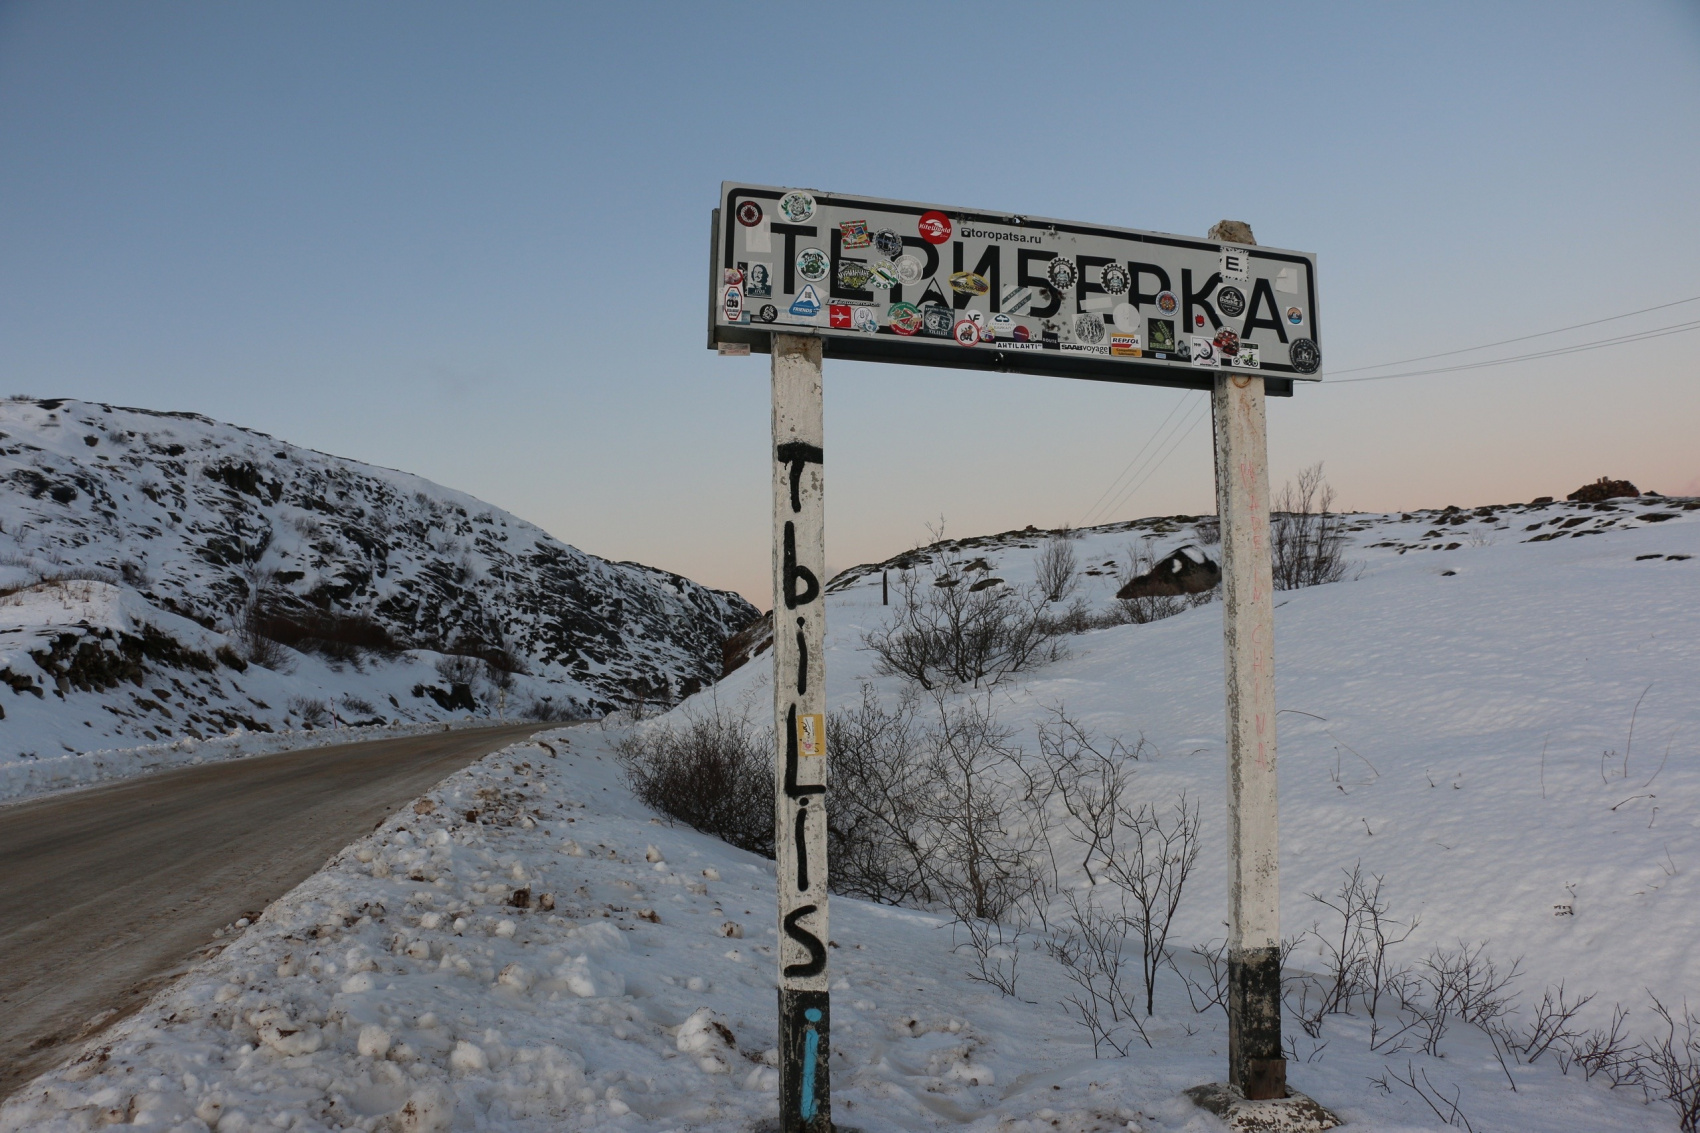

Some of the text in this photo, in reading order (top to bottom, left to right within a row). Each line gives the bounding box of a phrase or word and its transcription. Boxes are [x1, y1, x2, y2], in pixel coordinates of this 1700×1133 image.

[971, 228, 1042, 244] toropatsa.ru
[771, 221, 1289, 345] ТЕРИБЕРКА
[792, 306, 813, 314] FRIENDS
[1061, 344, 1108, 355] SAABvoyage
[1251, 624, 1266, 769] CHINA
